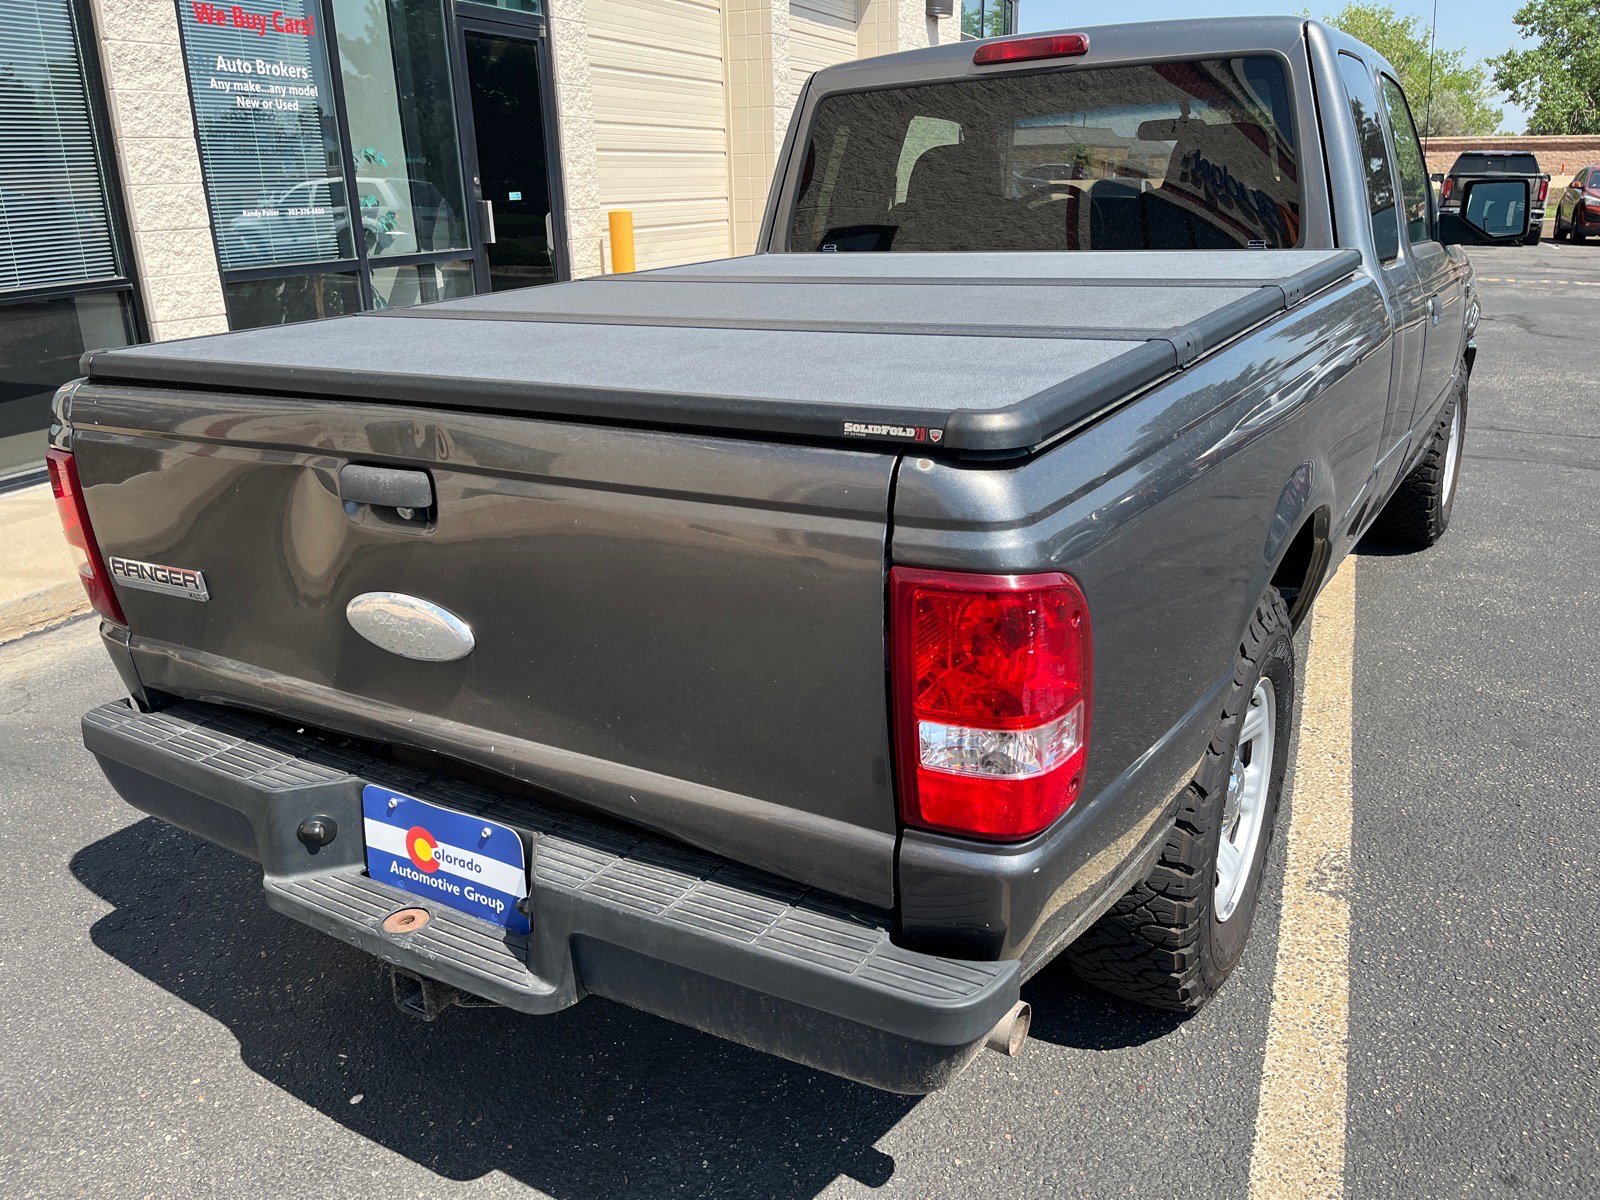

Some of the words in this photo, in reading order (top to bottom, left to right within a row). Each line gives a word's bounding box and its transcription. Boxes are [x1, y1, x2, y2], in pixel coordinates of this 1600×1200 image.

[193, 1, 227, 26] We
[231, 6, 267, 37] Buy
[272, 11, 316, 36] Cars!
[216, 55, 252, 74] Auto
[255, 59, 309, 79] Brokers
[210, 78, 231, 93] Any
[289, 86, 319, 97] model
[236, 96, 260, 108] New
[262, 101, 273, 109] or
[275, 99, 299, 111] Used
[843, 422, 915, 437] SOLIDFOLD
[111, 558, 200, 590] RANGER
[405, 825, 482, 874] Colorado
[390, 861, 461, 896] Automotive
[463, 886, 505, 914] Group
